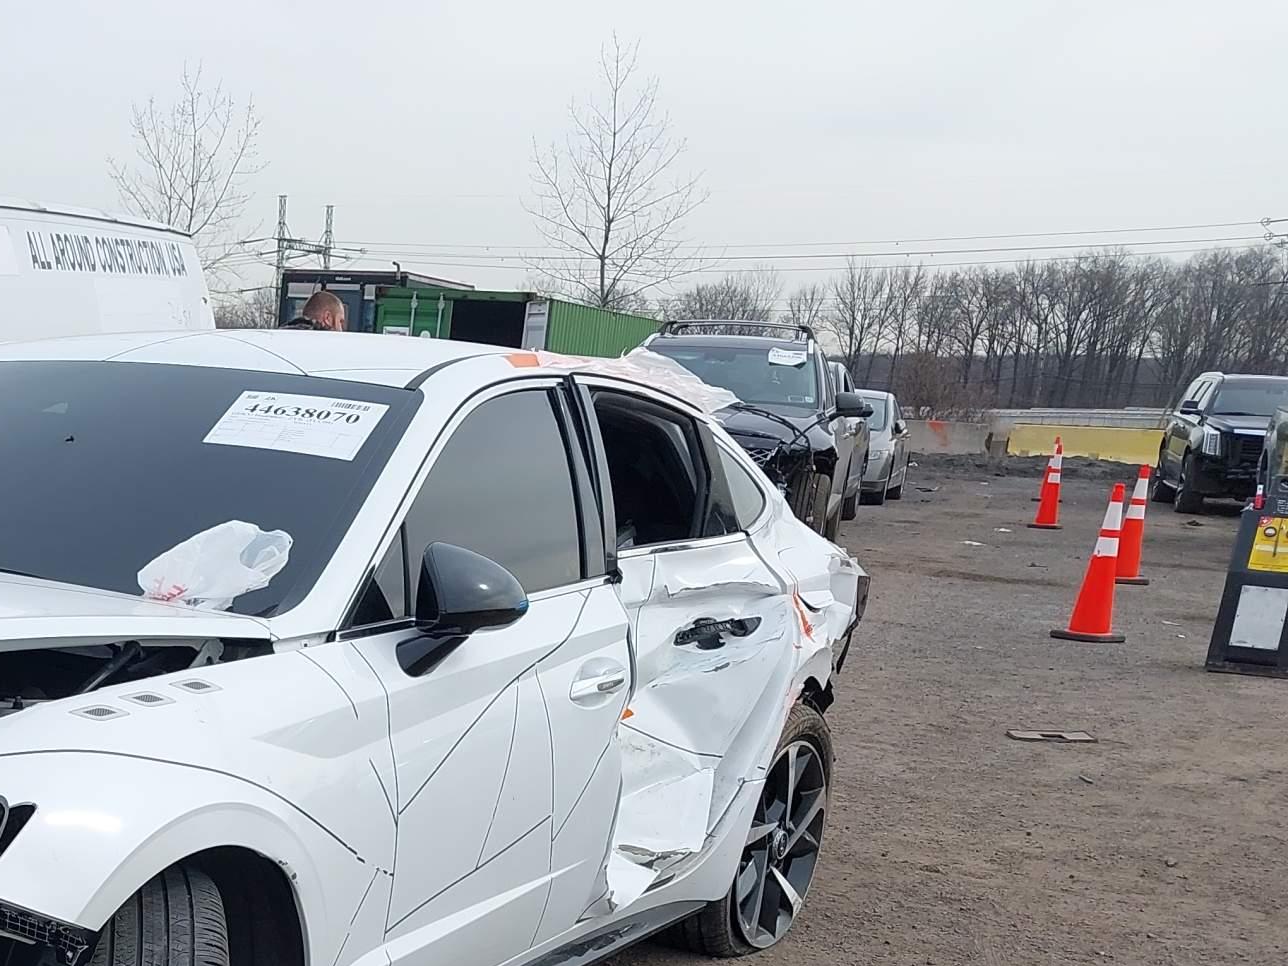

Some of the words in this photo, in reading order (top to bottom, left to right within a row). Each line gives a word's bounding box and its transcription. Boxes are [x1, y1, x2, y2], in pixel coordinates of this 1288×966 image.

[27, 232, 51, 269] ALL
[50, 232, 96, 272] AROUND
[165, 241, 188, 277] USA
[245, 402, 361, 425] 44638070
